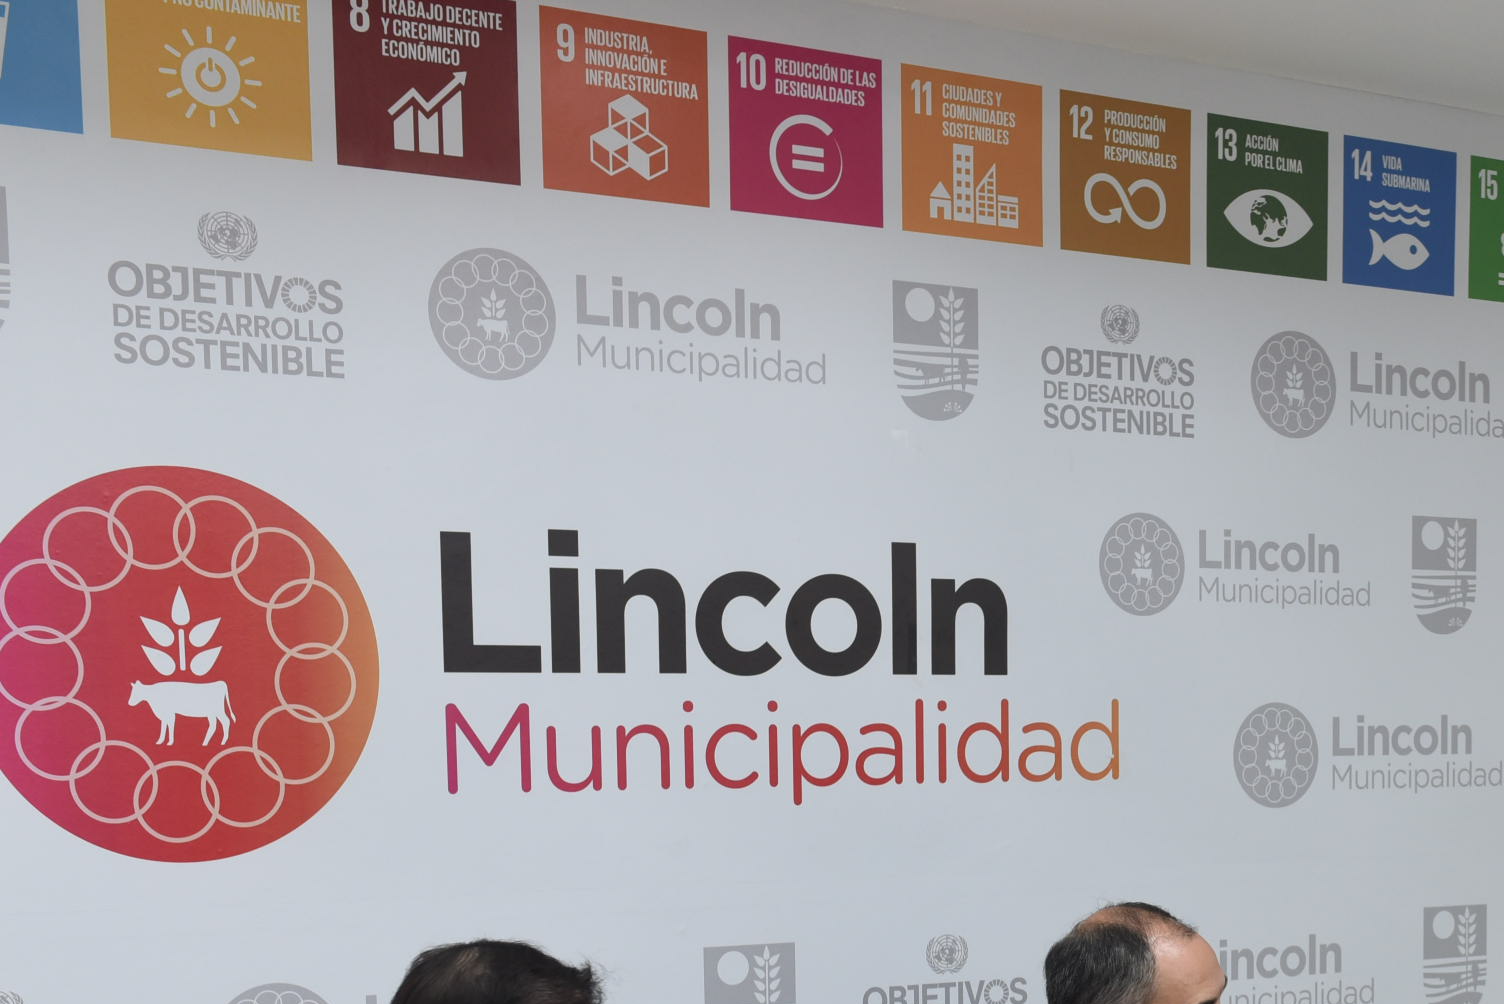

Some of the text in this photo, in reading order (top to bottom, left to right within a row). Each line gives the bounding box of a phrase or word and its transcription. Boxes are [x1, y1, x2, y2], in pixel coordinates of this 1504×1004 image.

[350, 0, 371, 33] 8
[381, 0, 503, 31] TRABAJO DECENTE
[381, 17, 480, 48] Y CRECIMIENTO
[556, 23, 575, 62] 9
[585, 27, 652, 54] INDUSTRIA,
[381, 38, 460, 66] ECONÓMICO
[585, 48, 668, 76] INNOVACIÓN E
[585, 68, 699, 100] INFRAESTRUCTURA
[736, 52, 767, 91] 10
[775, 57, 877, 88] REDUCCIÓN DE LAS
[775, 78, 865, 107] DESIGUALDADES
[911, 79, 932, 116] 11
[942, 83, 1002, 107] CIUDADES Y
[942, 102, 1016, 128] COMUNIDADES
[1069, 104, 1093, 140] 12
[1104, 109, 1166, 133] PRODUCCIÓN
[942, 121, 1009, 145] SOSTENIBLES
[1104, 127, 1160, 149] Y CONSUMO
[1214, 127, 1238, 161] 13
[1245, 134, 1279, 152] ACCIÓN
[1104, 145, 1177, 169] RESPONSABLES
[1245, 151, 1303, 174] POR EL CLIMA
[1351, 148, 1373, 181] 14
[1382, 154, 1402, 171] VIDA
[1382, 172, 1431, 192] SUBMARINA
[1478, 168, 1498, 200] 15
[107, 260, 344, 315] OBJETIVOS
[112, 303, 344, 344] DE DESARROLLO
[575, 274, 781, 342] Lincoln
[113, 332, 345, 379] SOSTENIBLE
[577, 333, 826, 385] Municipalidad
[1041, 345, 1195, 387] OBJETIVOS
[1350, 351, 1490, 404] Lincoln
[1043, 380, 1195, 410] DE DESARROLLO
[1043, 402, 1195, 439] SOSTENIBLE
[1199, 529, 1340, 573] Lincoln
[440, 528, 1008, 676] Lincoln
[1199, 575, 1371, 609] Municipalidad
[1332, 714, 1473, 756] Lincoln
[445, 698, 1119, 806] Municipalidad
[1332, 760, 1503, 794] Municipalidad
[1219, 934, 1342, 980] incoln
